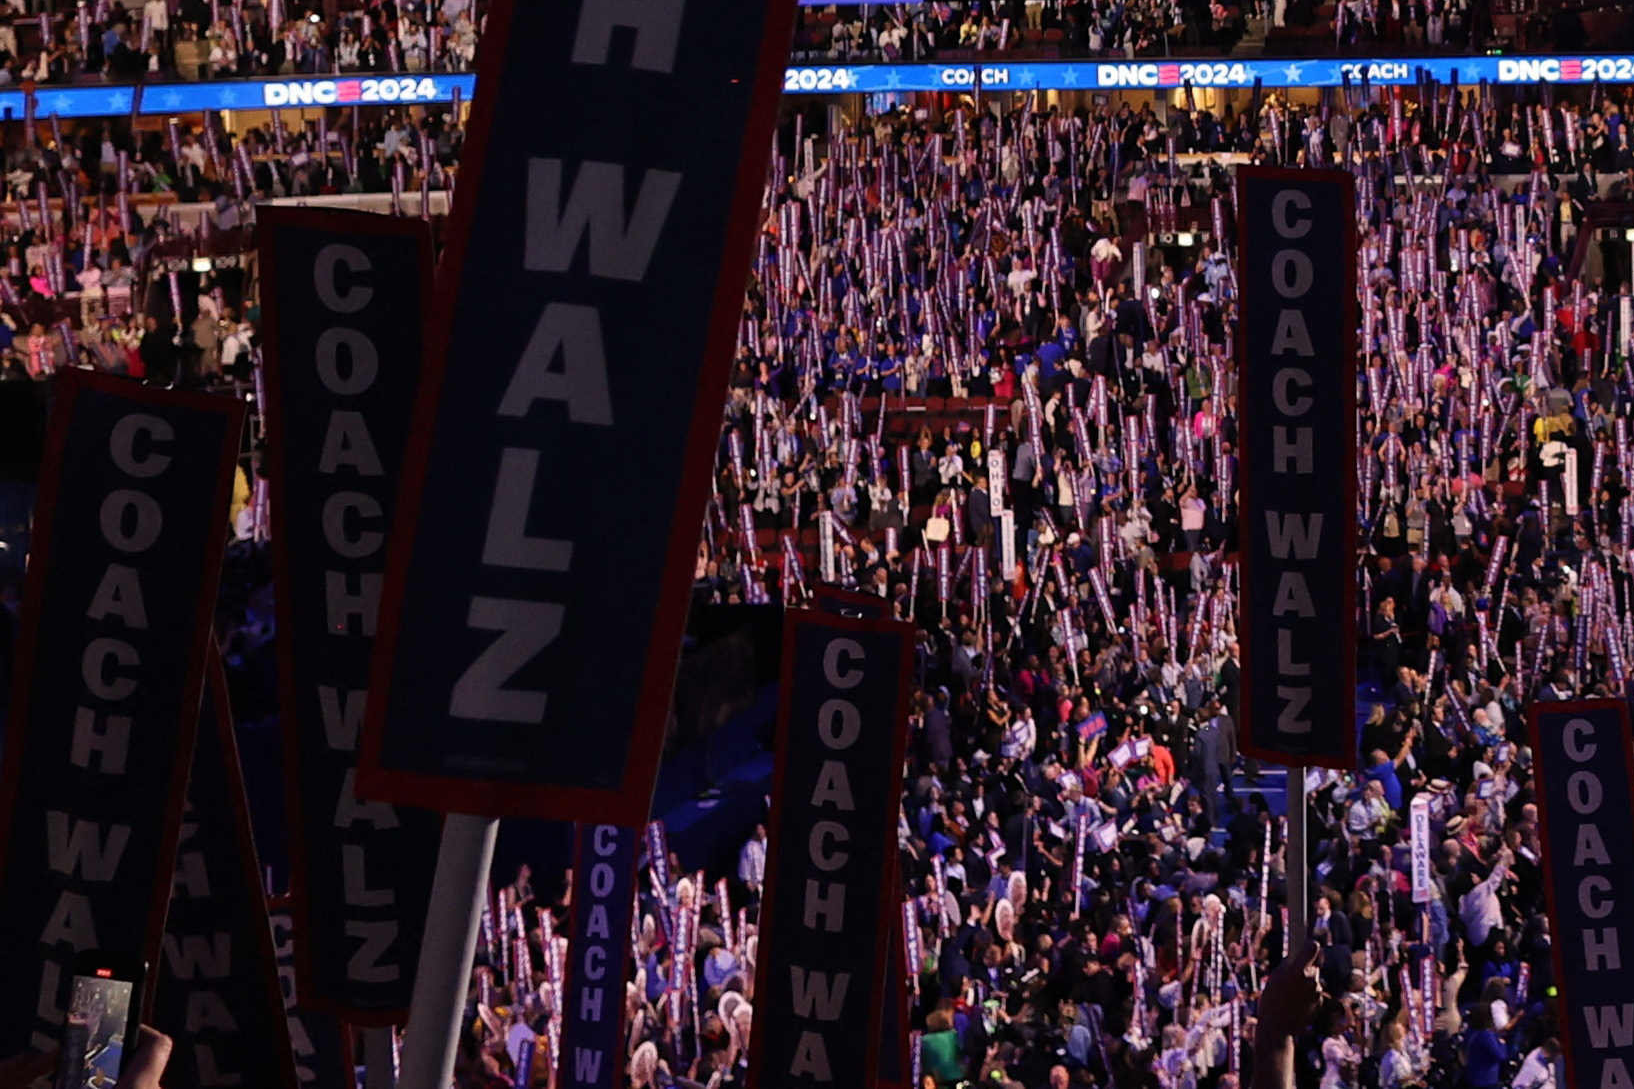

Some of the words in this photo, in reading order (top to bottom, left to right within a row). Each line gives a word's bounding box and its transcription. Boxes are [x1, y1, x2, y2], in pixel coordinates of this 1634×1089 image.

[264, 82, 336, 106] DNC
[361, 78, 437, 101] 2024
[784, 68, 850, 91] 2024
[1097, 64, 1158, 87] DNC
[1180, 63, 1247, 85] 2024
[1498, 58, 1560, 82] DNC
[1271, 189, 1316, 475] COACH
[312, 243, 386, 637] COACH
[447, 157, 681, 724] WALZ
[69, 413, 177, 776] COACH
[1265, 510, 1325, 734] WALZ
[803, 637, 866, 934] COACH
[1562, 718, 1622, 971] COACH
[163, 931, 243, 1088] WAL
[579, 824, 619, 1022] COACH
[789, 964, 851, 1082] WA
